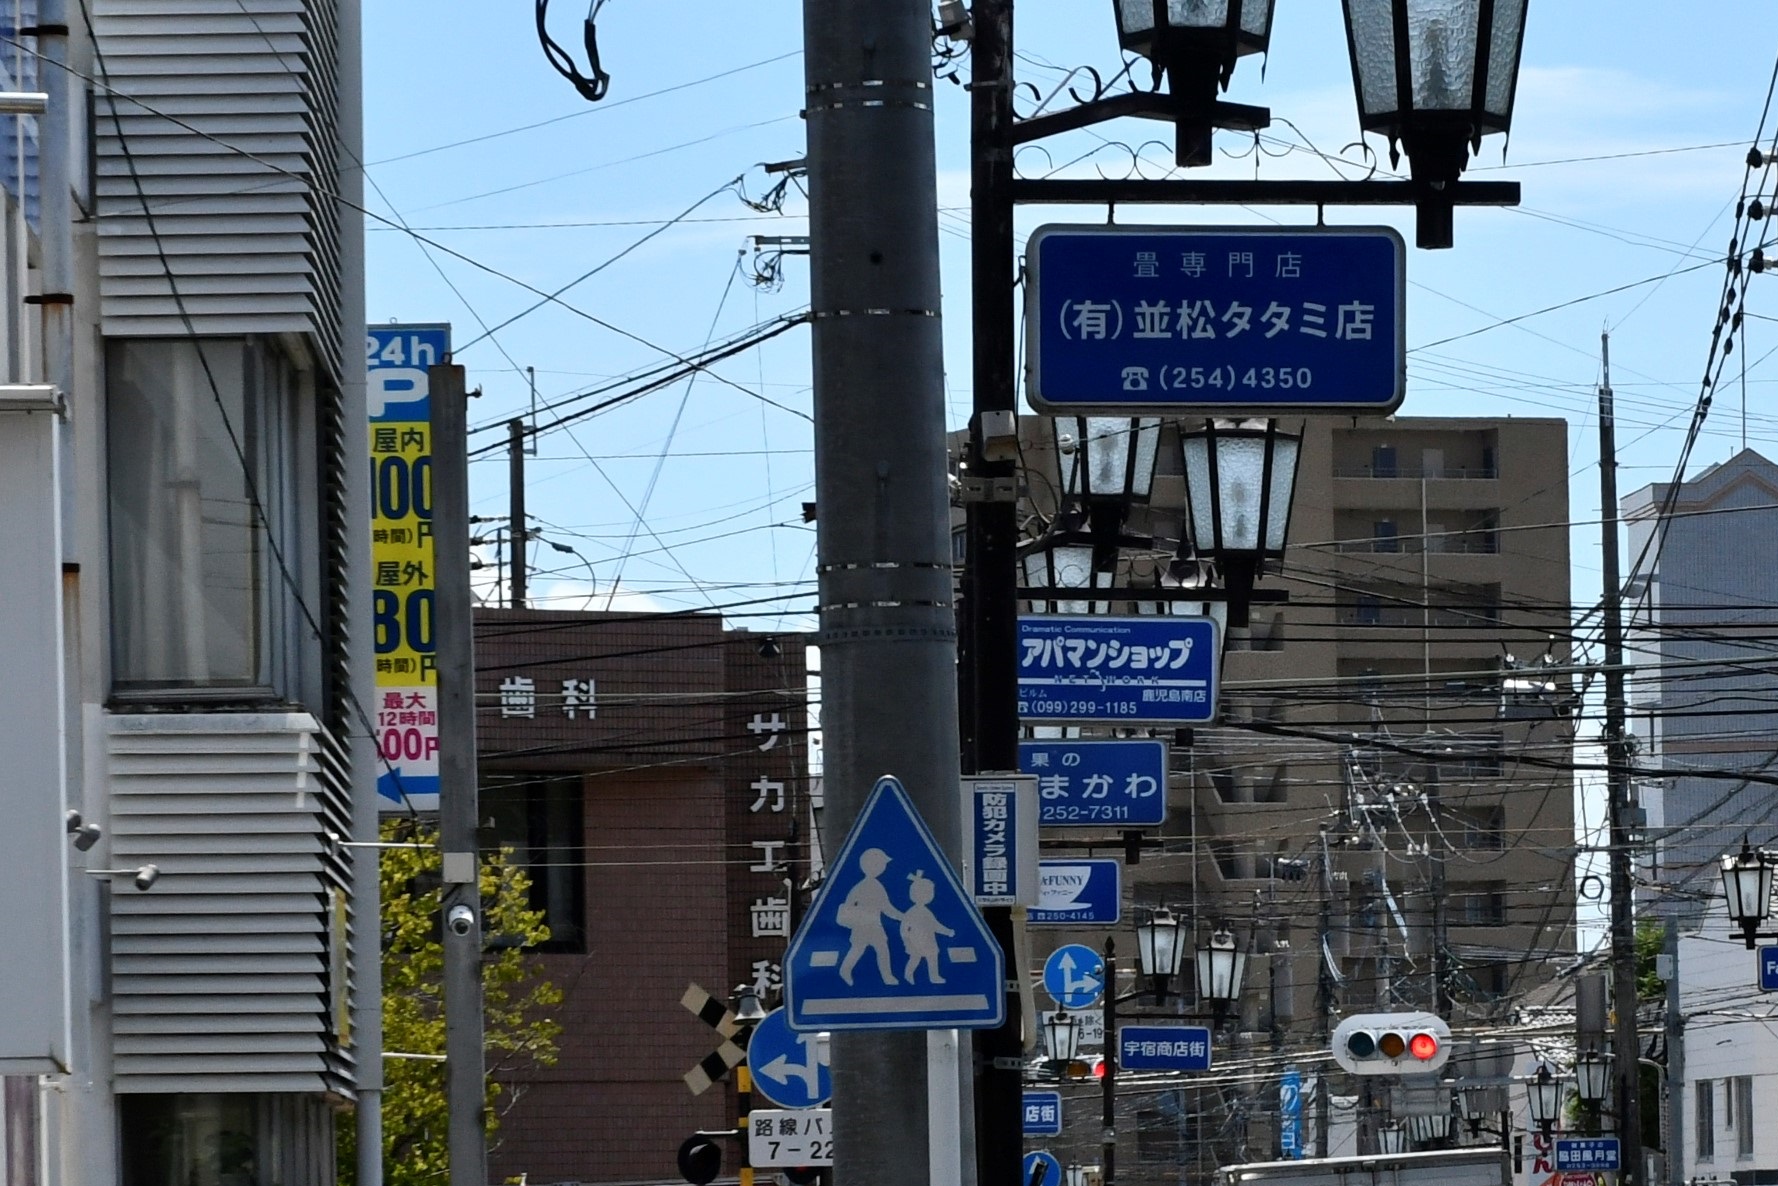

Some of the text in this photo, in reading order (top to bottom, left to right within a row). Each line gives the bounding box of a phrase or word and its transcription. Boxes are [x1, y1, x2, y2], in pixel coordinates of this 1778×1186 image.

[1133, 251, 1303, 281] 畳専門店
[1058, 300, 1375, 342] (有)並松タタミ店
[1159, 365, 1313, 391] (254)4350
[373, 427, 425, 453] 屋内
[376, 561, 429, 586] 屋外
[1021, 636, 1194, 670] アパマンショップ
[383, 692, 427, 710] 最大
[1142, 689, 1207, 703] 鹿児島南店
[1031, 700, 1138, 715] (099)299-1185
[1043, 805, 1129, 820] 252-7311
[1123, 1040, 1206, 1058] 宇宿商店街
[1025, 1105, 1055, 1122] 店街
[755, 1117, 833, 1137] 路線バ
